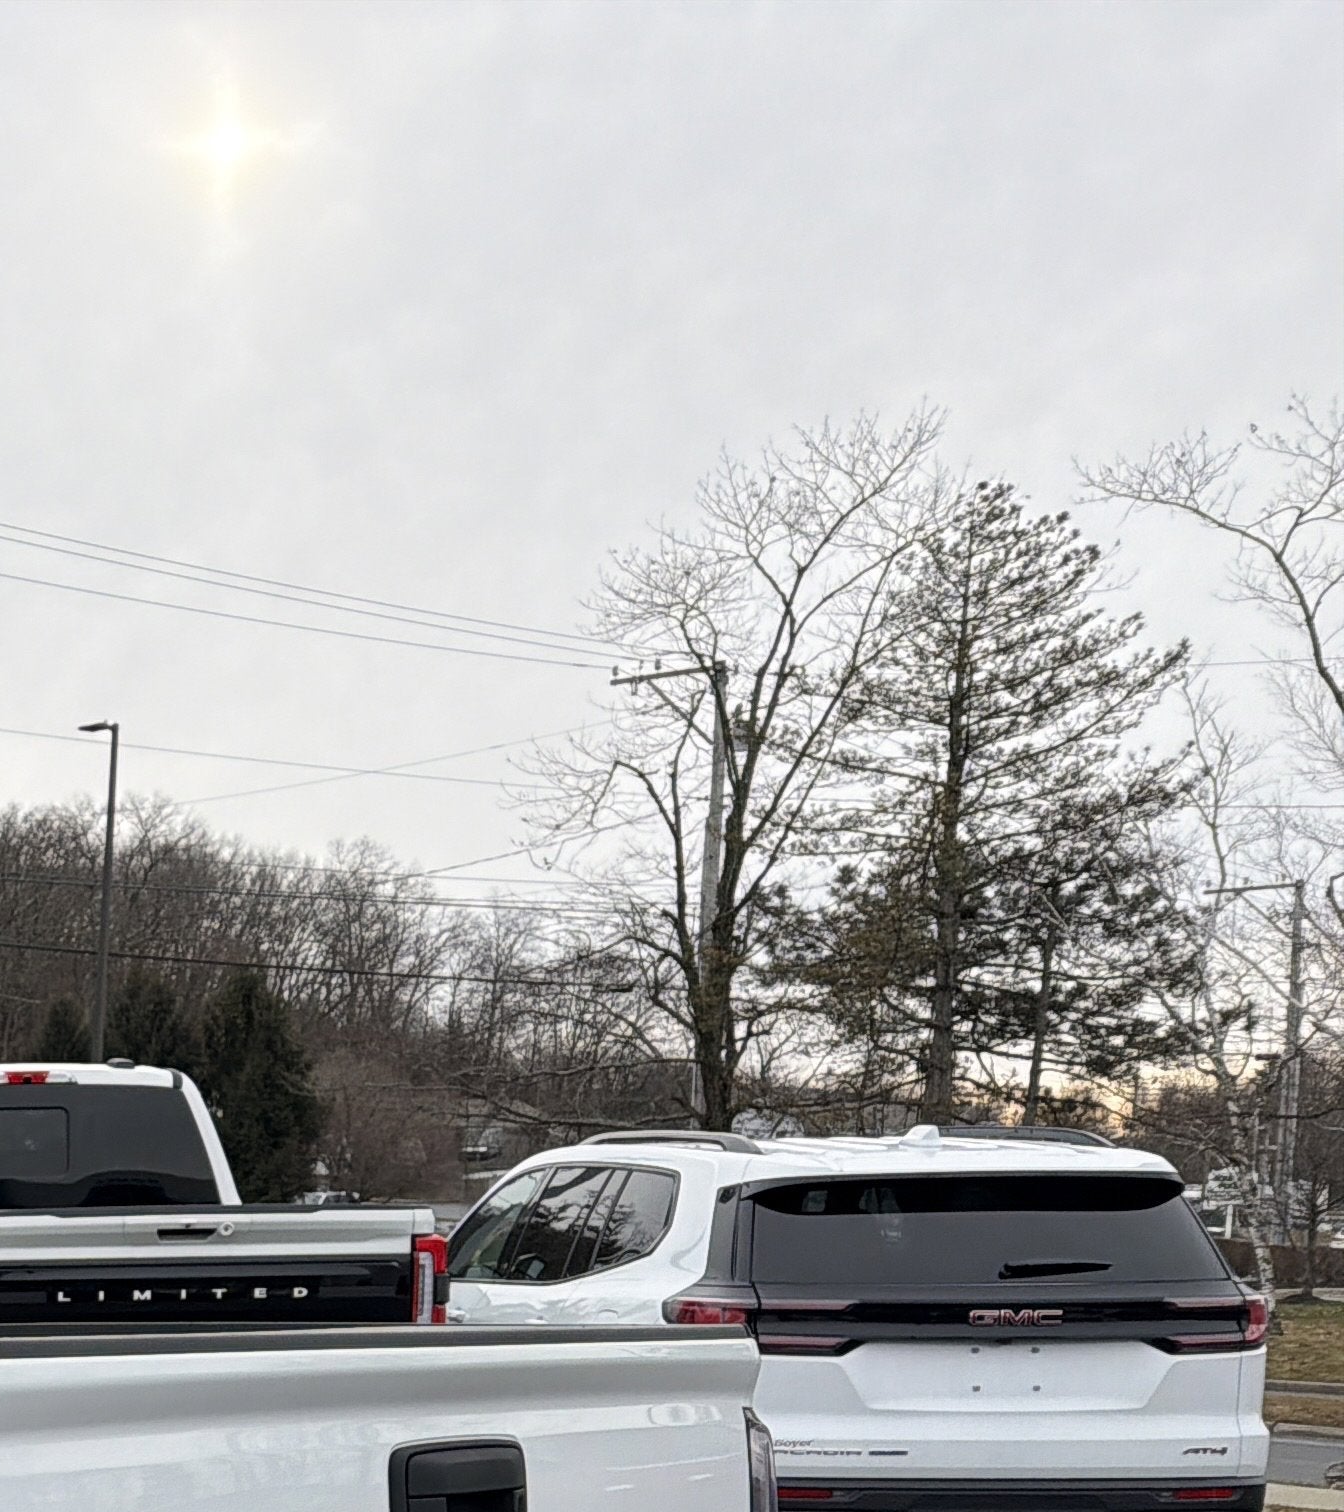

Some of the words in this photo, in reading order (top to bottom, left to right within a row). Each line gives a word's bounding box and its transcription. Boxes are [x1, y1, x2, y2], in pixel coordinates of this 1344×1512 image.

[56, 1286, 309, 1302] LIMITED
[969, 1309, 1064, 1326] GMC
[1182, 1446, 1228, 1456] AT4
